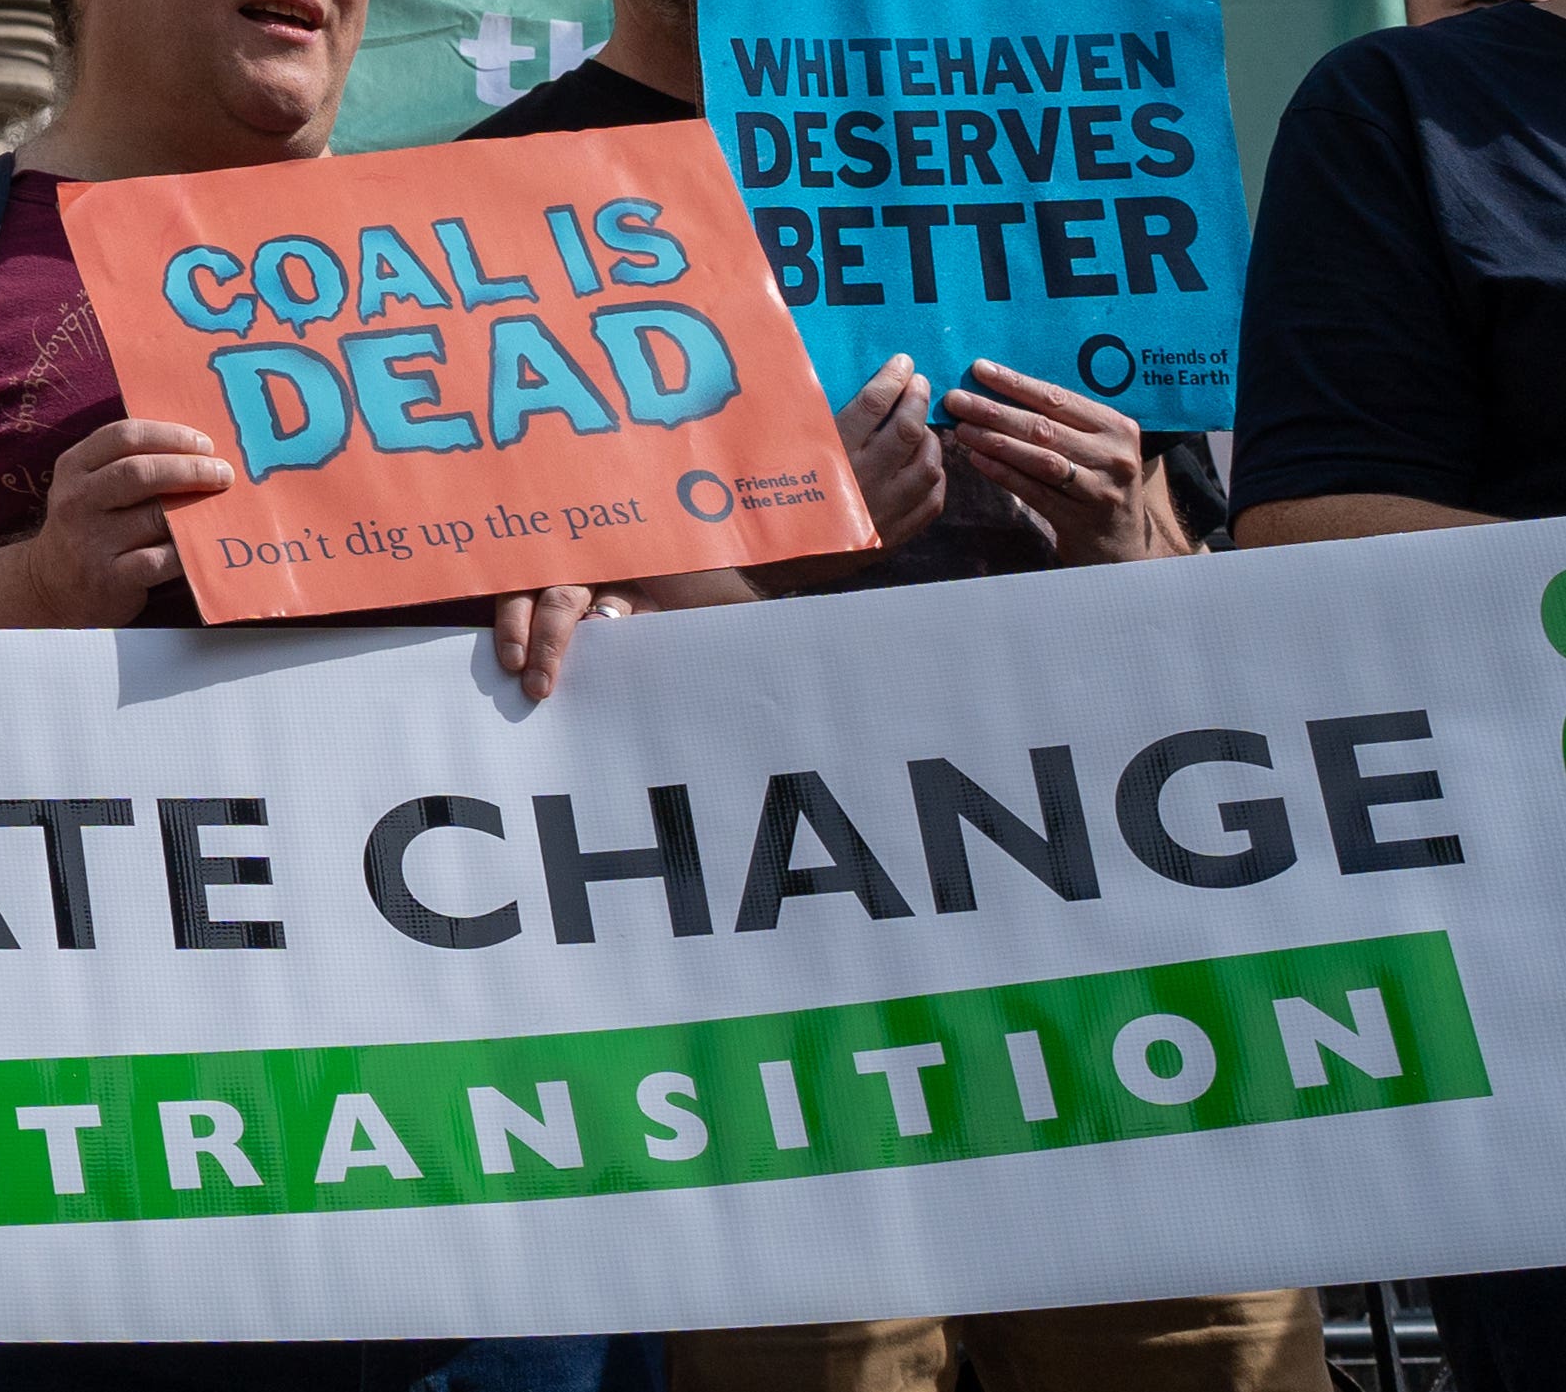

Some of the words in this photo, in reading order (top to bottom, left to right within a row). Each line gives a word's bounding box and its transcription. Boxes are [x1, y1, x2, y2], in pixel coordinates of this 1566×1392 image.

[730, 30, 1175, 99] WHITEHAVEN
[736, 102, 1197, 190] DESERVES
[162, 217, 539, 339] COAL
[544, 197, 691, 297] IS
[752, 195, 1209, 307] BETTER
[207, 299, 742, 486] DEAD
[1141, 348, 1207, 365] Friends
[1209, 349, 1228, 364] of
[1142, 370, 1174, 386] the
[1178, 369, 1230, 386] Earth
[734, 473, 799, 493] Friends
[801, 470, 818, 484] of
[741, 495, 772, 510] the
[773, 488, 826, 506] Earth
[216, 529, 335, 571] Don’t
[344, 516, 414, 564] dig
[418, 515, 478, 556] up
[486, 505, 552, 540] the
[561, 496, 647, 542] past
[363, 708, 1465, 950] CHANGE
[16, 987, 1407, 1196] TRANSITION
